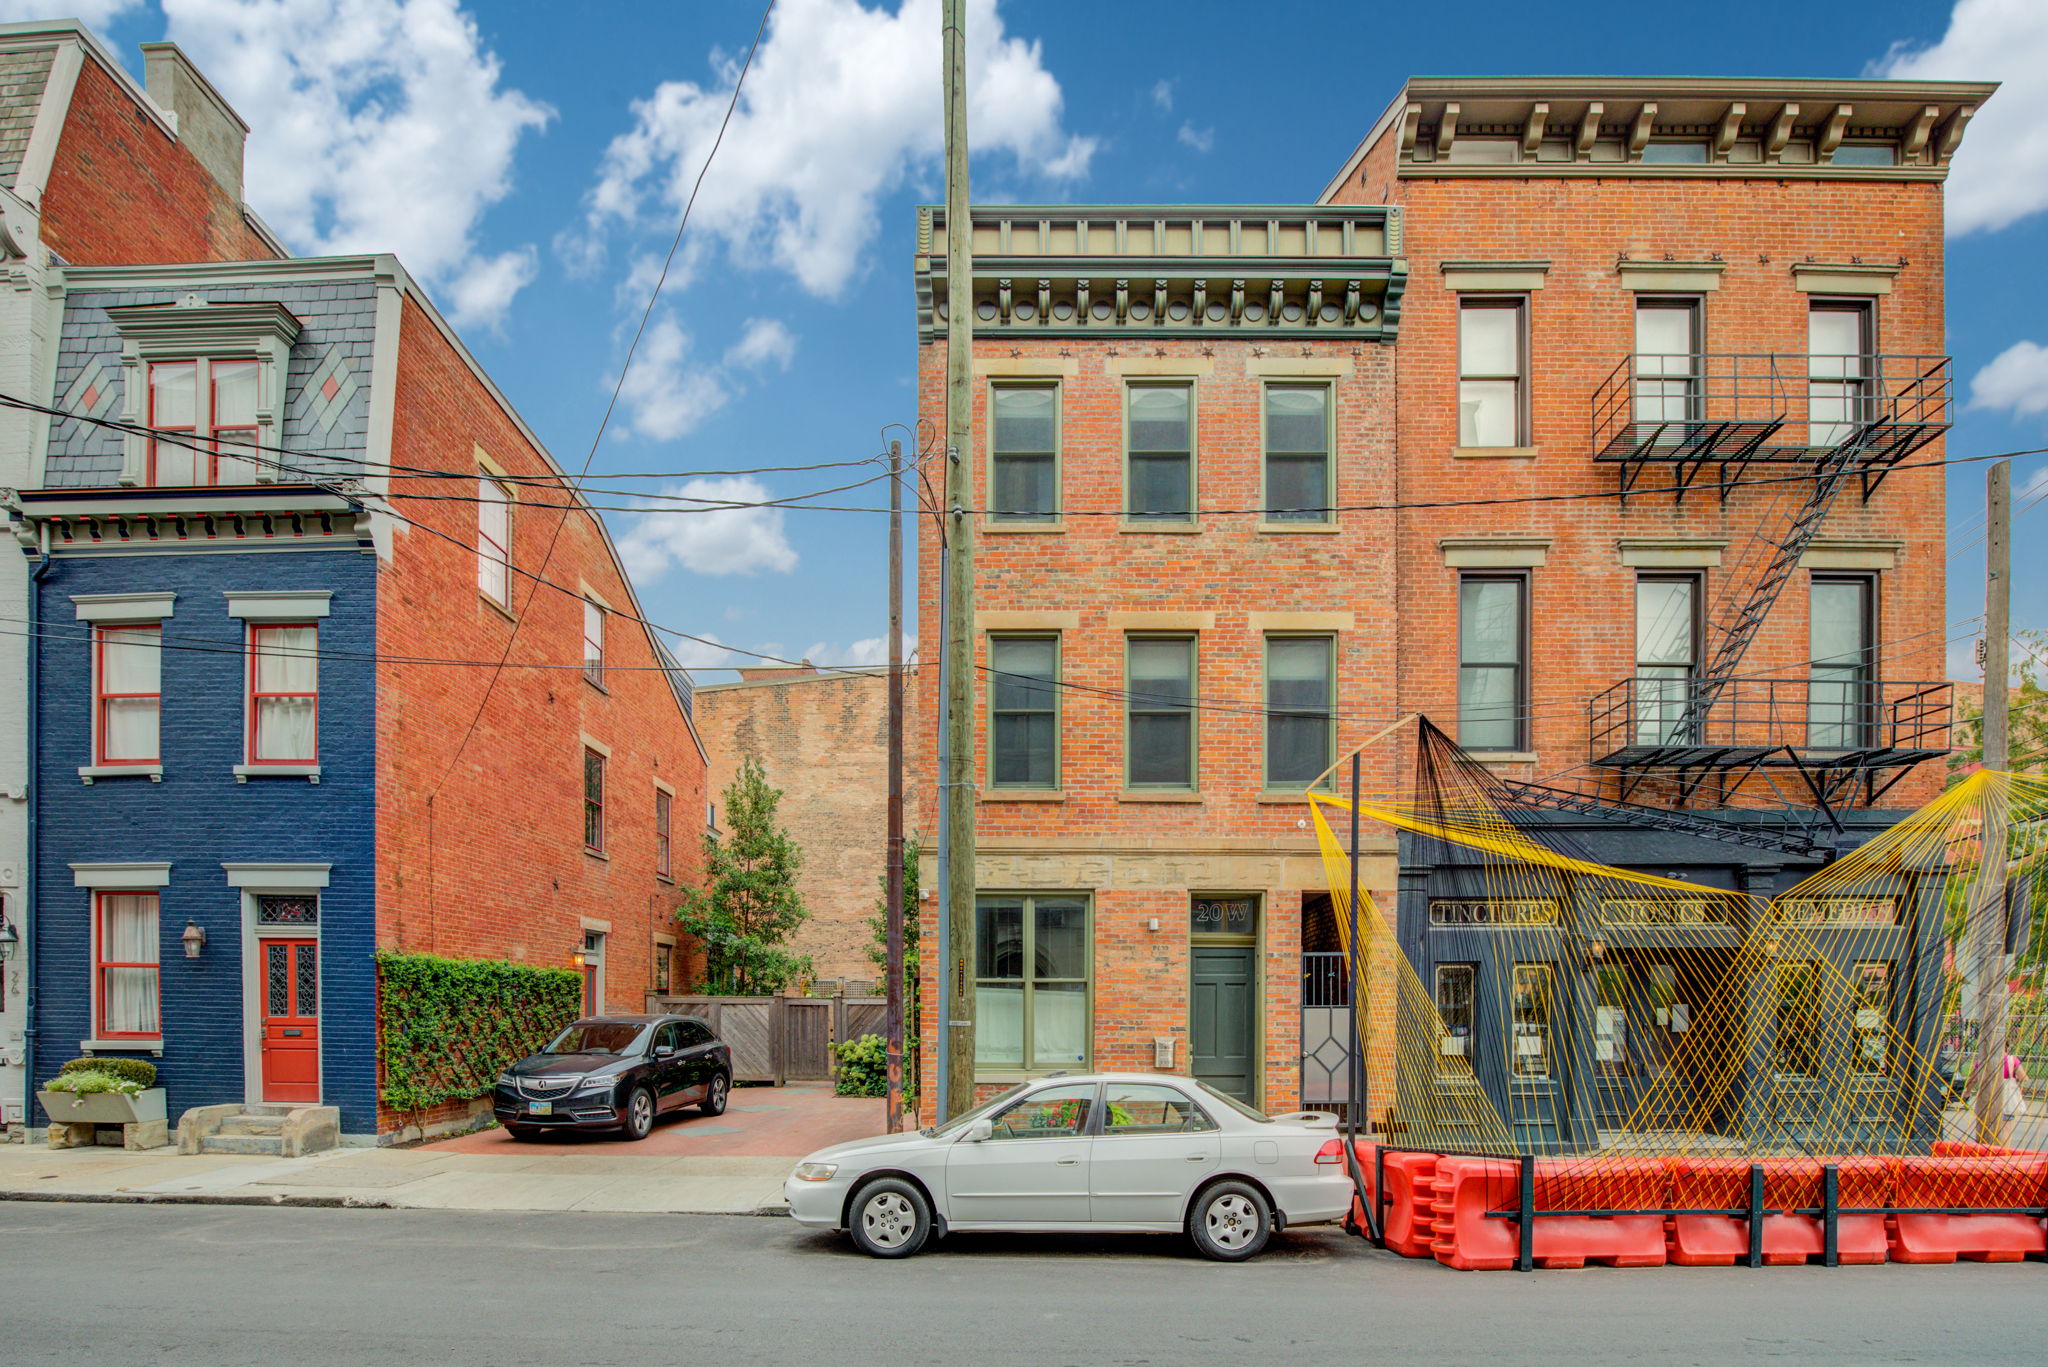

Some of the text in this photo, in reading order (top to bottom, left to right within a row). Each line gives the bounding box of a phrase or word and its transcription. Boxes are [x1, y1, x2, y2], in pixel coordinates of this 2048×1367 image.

[1437, 904, 1554, 923] TINCTURES
[1625, 903, 1706, 922] TONICS
[1783, 902, 1894, 921] REMEDI
